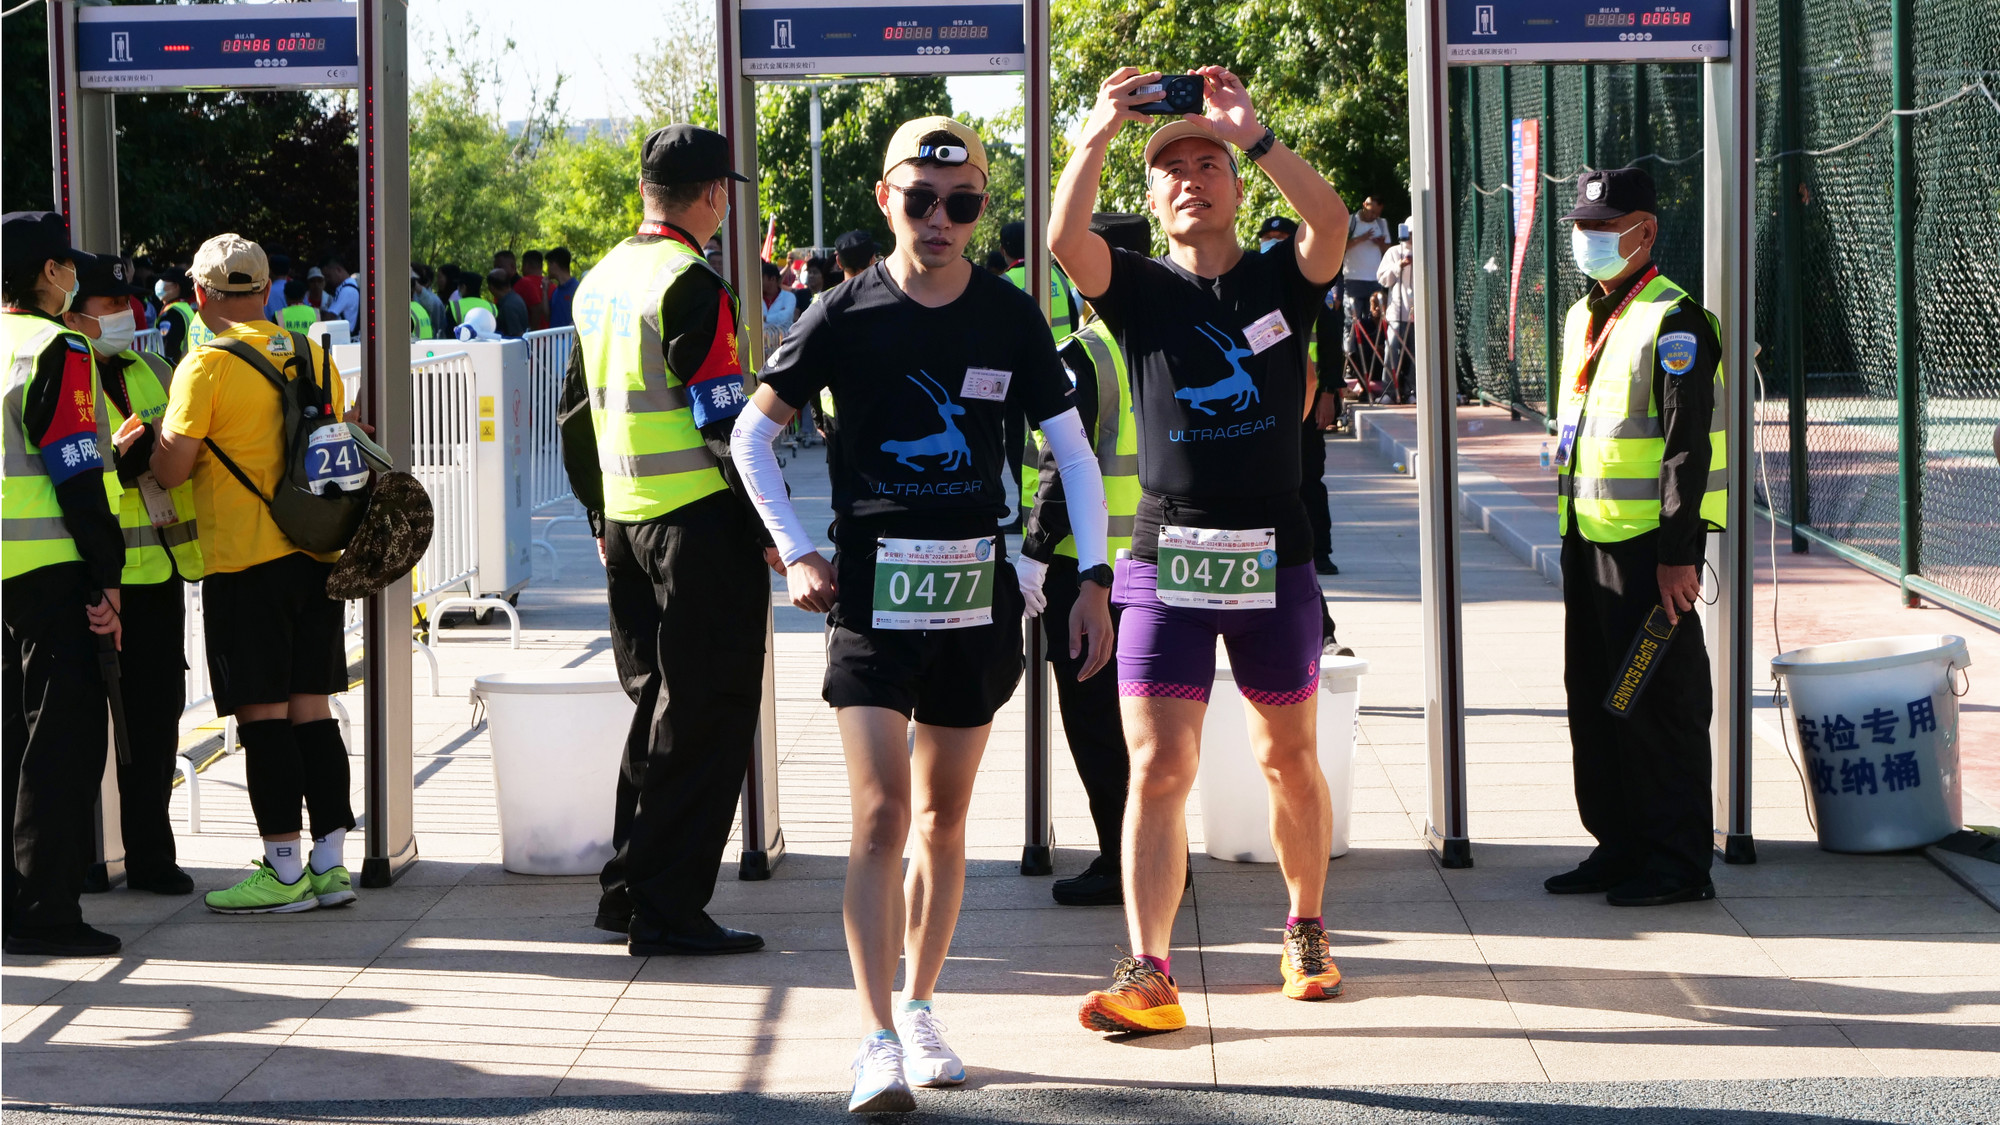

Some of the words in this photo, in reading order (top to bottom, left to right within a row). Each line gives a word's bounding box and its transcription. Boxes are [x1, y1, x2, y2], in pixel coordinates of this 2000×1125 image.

[1642, 12, 1692, 25] 00658
[581, 288, 634, 337] 安检
[711, 382, 748, 409] 泰网
[1168, 415, 1277, 444] ULTRAGEAR
[61, 438, 102, 467] 泰网
[868, 480, 983, 496] ULTRAGEAR
[889, 570, 982, 605] 0477
[1171, 555, 1260, 588] 0478
[1633, 638, 1659, 671] SUPER
[1610, 667, 1643, 711] SCANNER
[1796, 695, 1937, 753] 安检专用
[1809, 750, 1921, 796] 收纳桶
